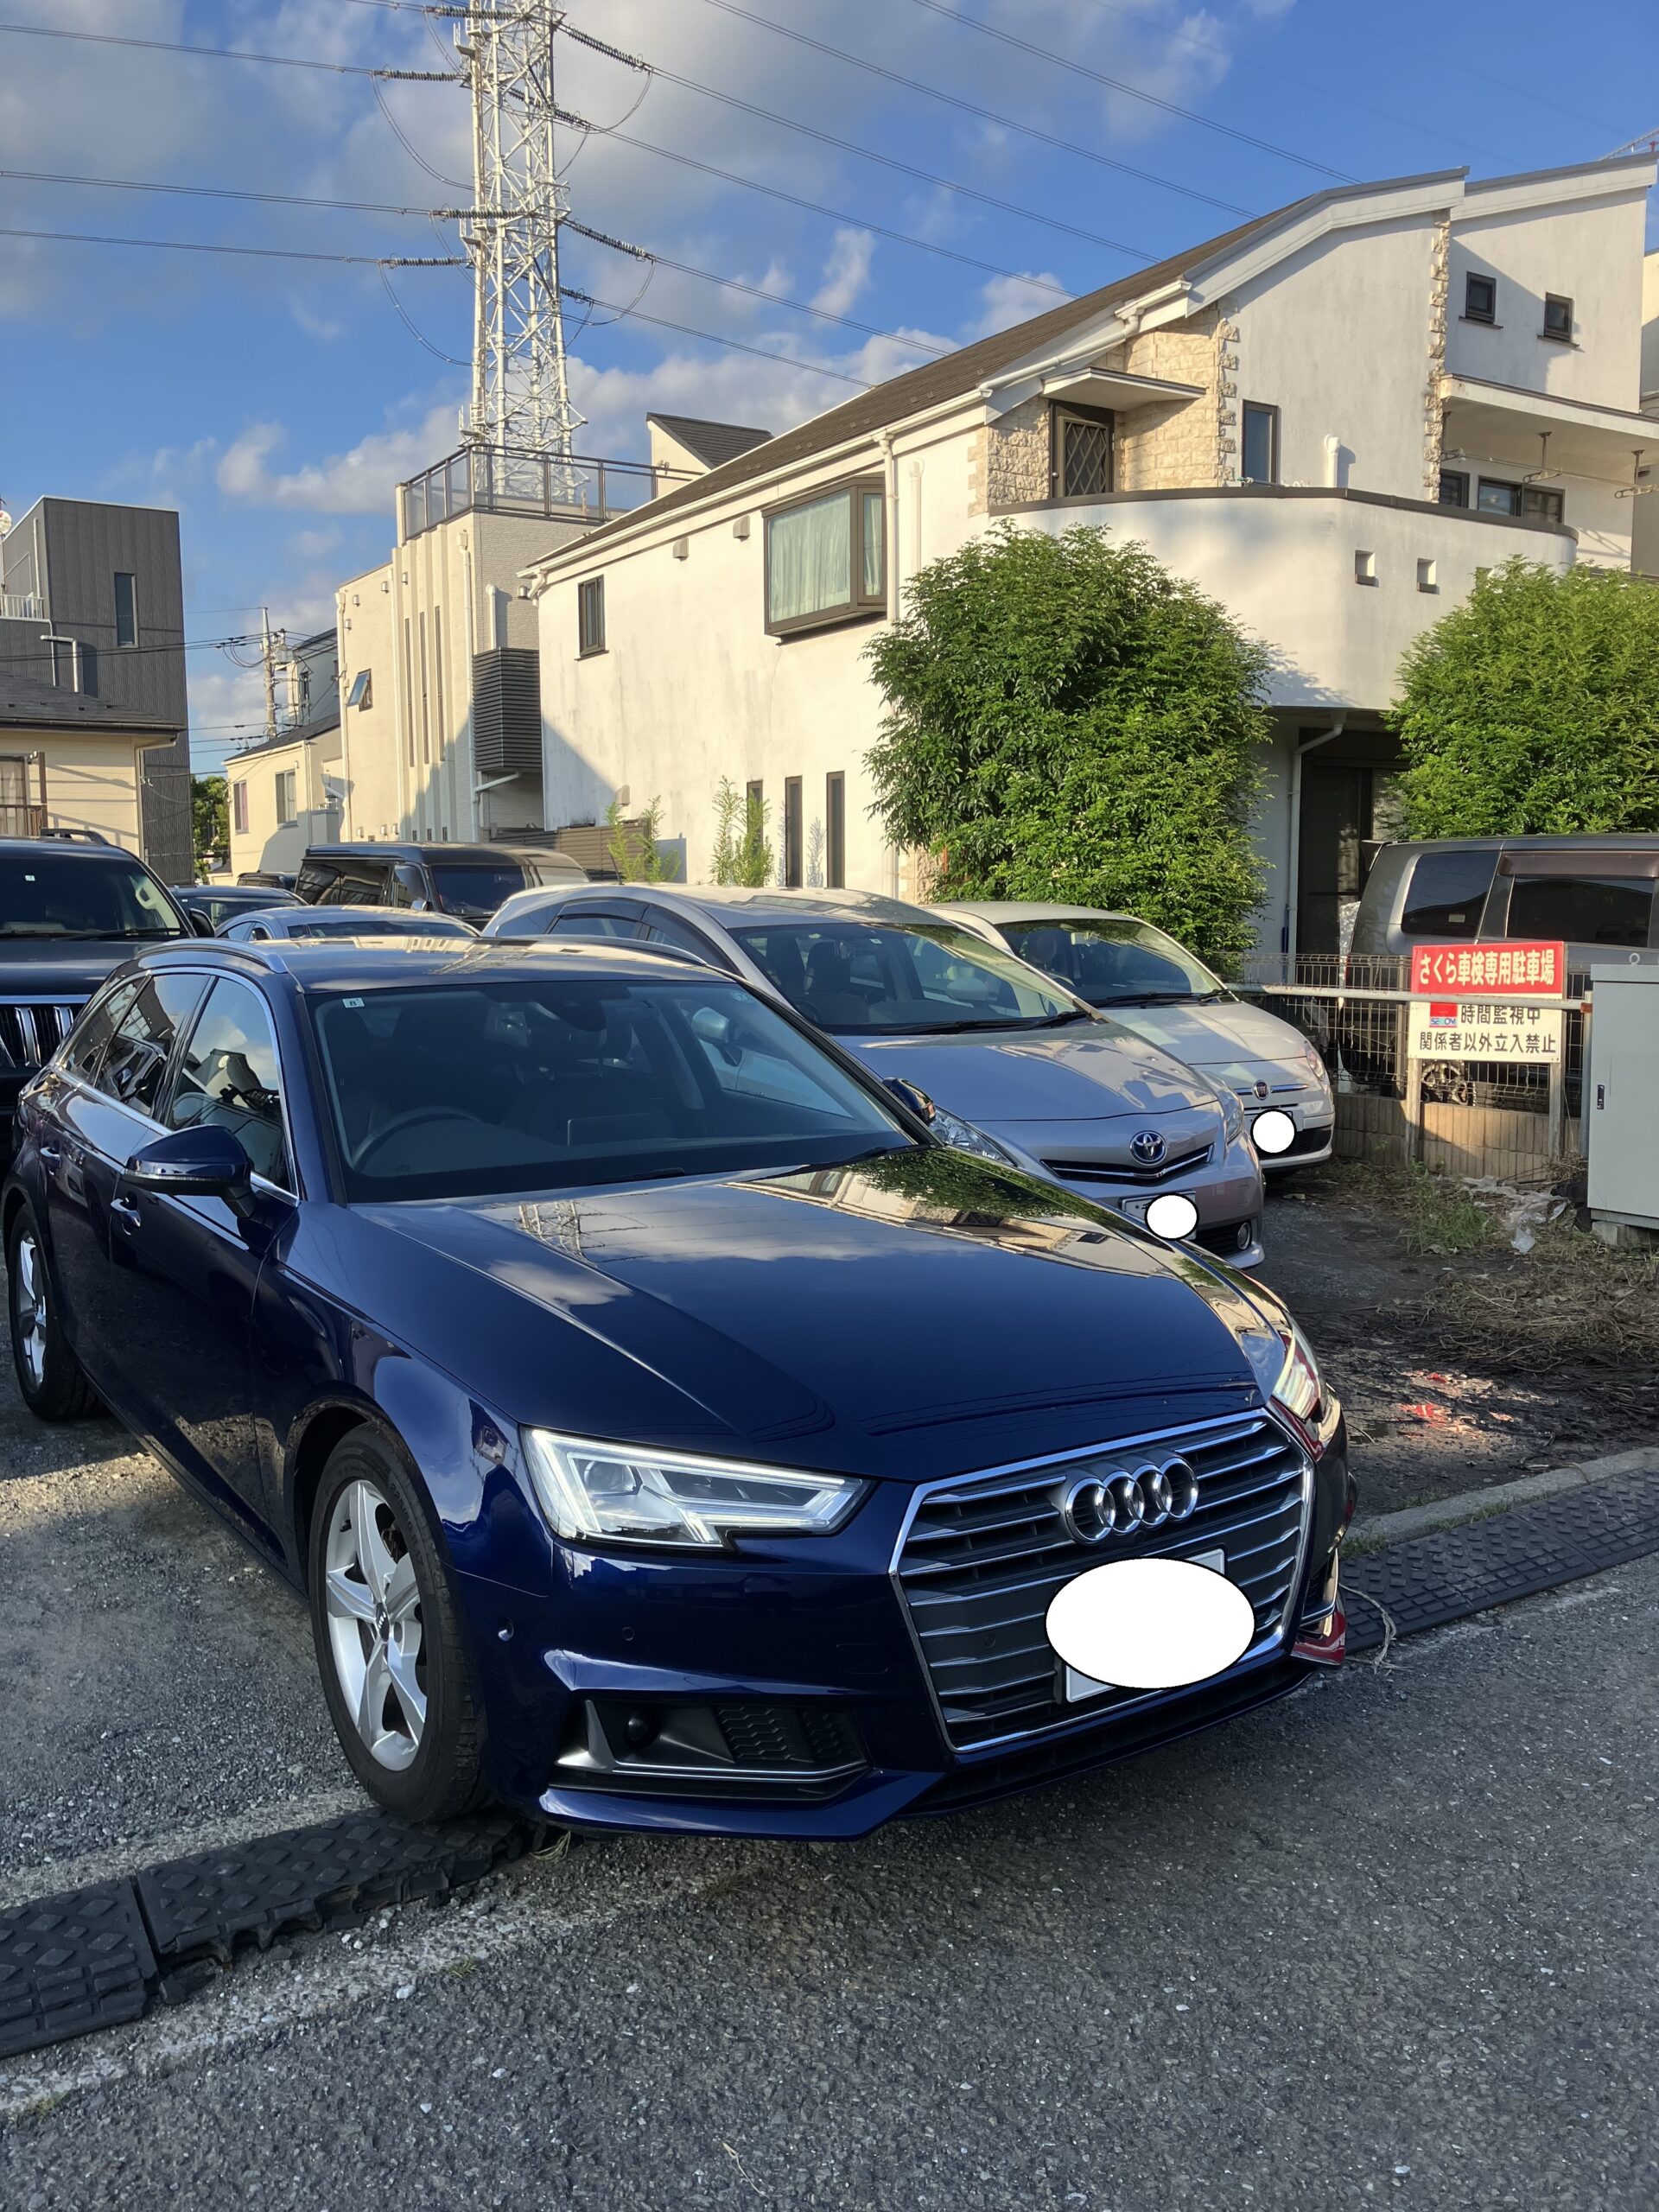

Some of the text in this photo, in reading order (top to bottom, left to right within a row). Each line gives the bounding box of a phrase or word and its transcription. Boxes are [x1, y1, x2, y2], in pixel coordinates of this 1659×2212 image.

[1420, 949, 1554, 986] さくら車検専用駐車場
[1460, 1005, 1541, 1026] 時間監視中
[1420, 1032, 1556, 1054] 関係者以外立入禁止
